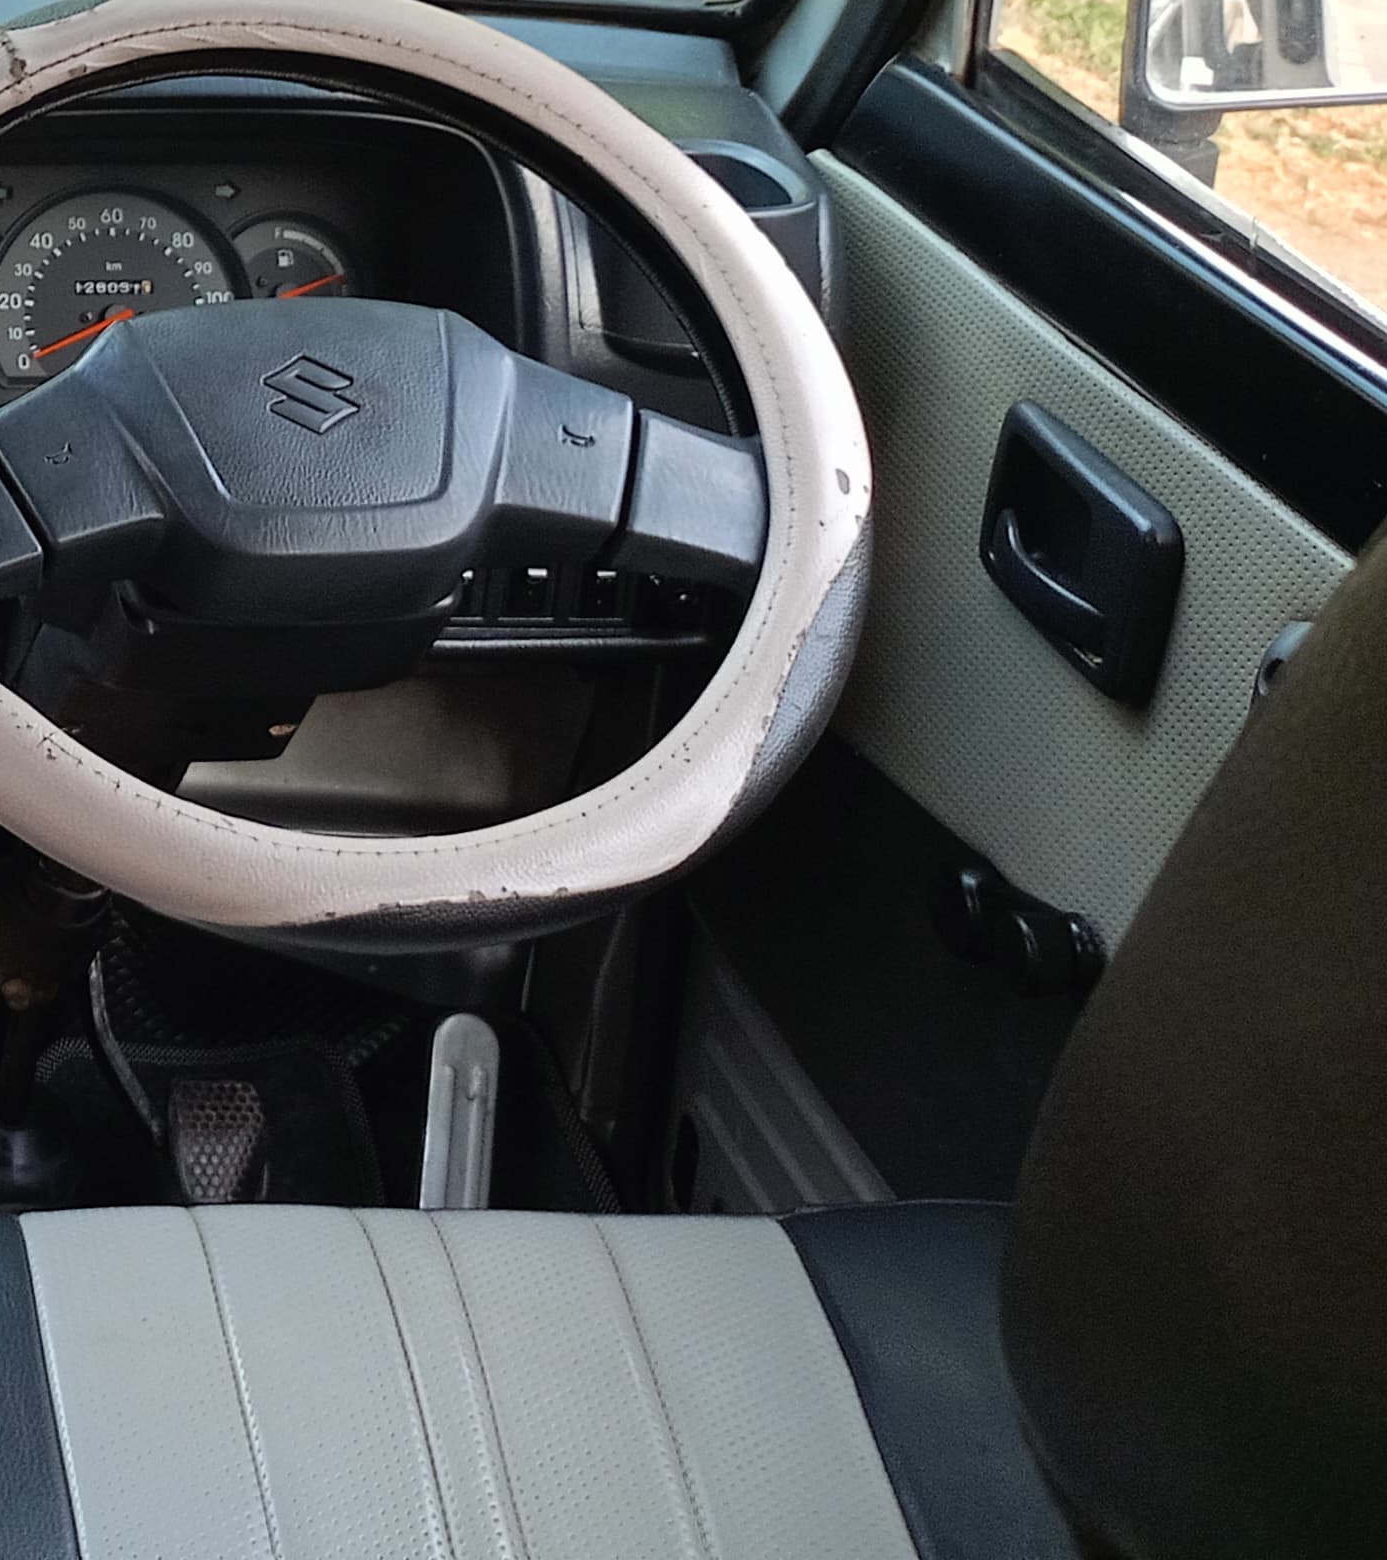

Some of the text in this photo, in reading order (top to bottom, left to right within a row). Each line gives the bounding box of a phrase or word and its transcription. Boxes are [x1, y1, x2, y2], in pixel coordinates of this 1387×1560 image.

[100, 208, 123, 224] 60
[68, 217, 86, 231] 50
[140, 217, 157, 230] 70
[30, 233, 53, 249] 40
[171, 231, 194, 248] 80
[14, 263, 32, 277] 30
[105, 261, 123, 272] km
[194, 261, 212, 275] 90
[0, 293, 22, 310] 20
[205, 291, 234, 304] 100
[8, 327, 23, 340] 10
[18, 354, 30, 370] 0
